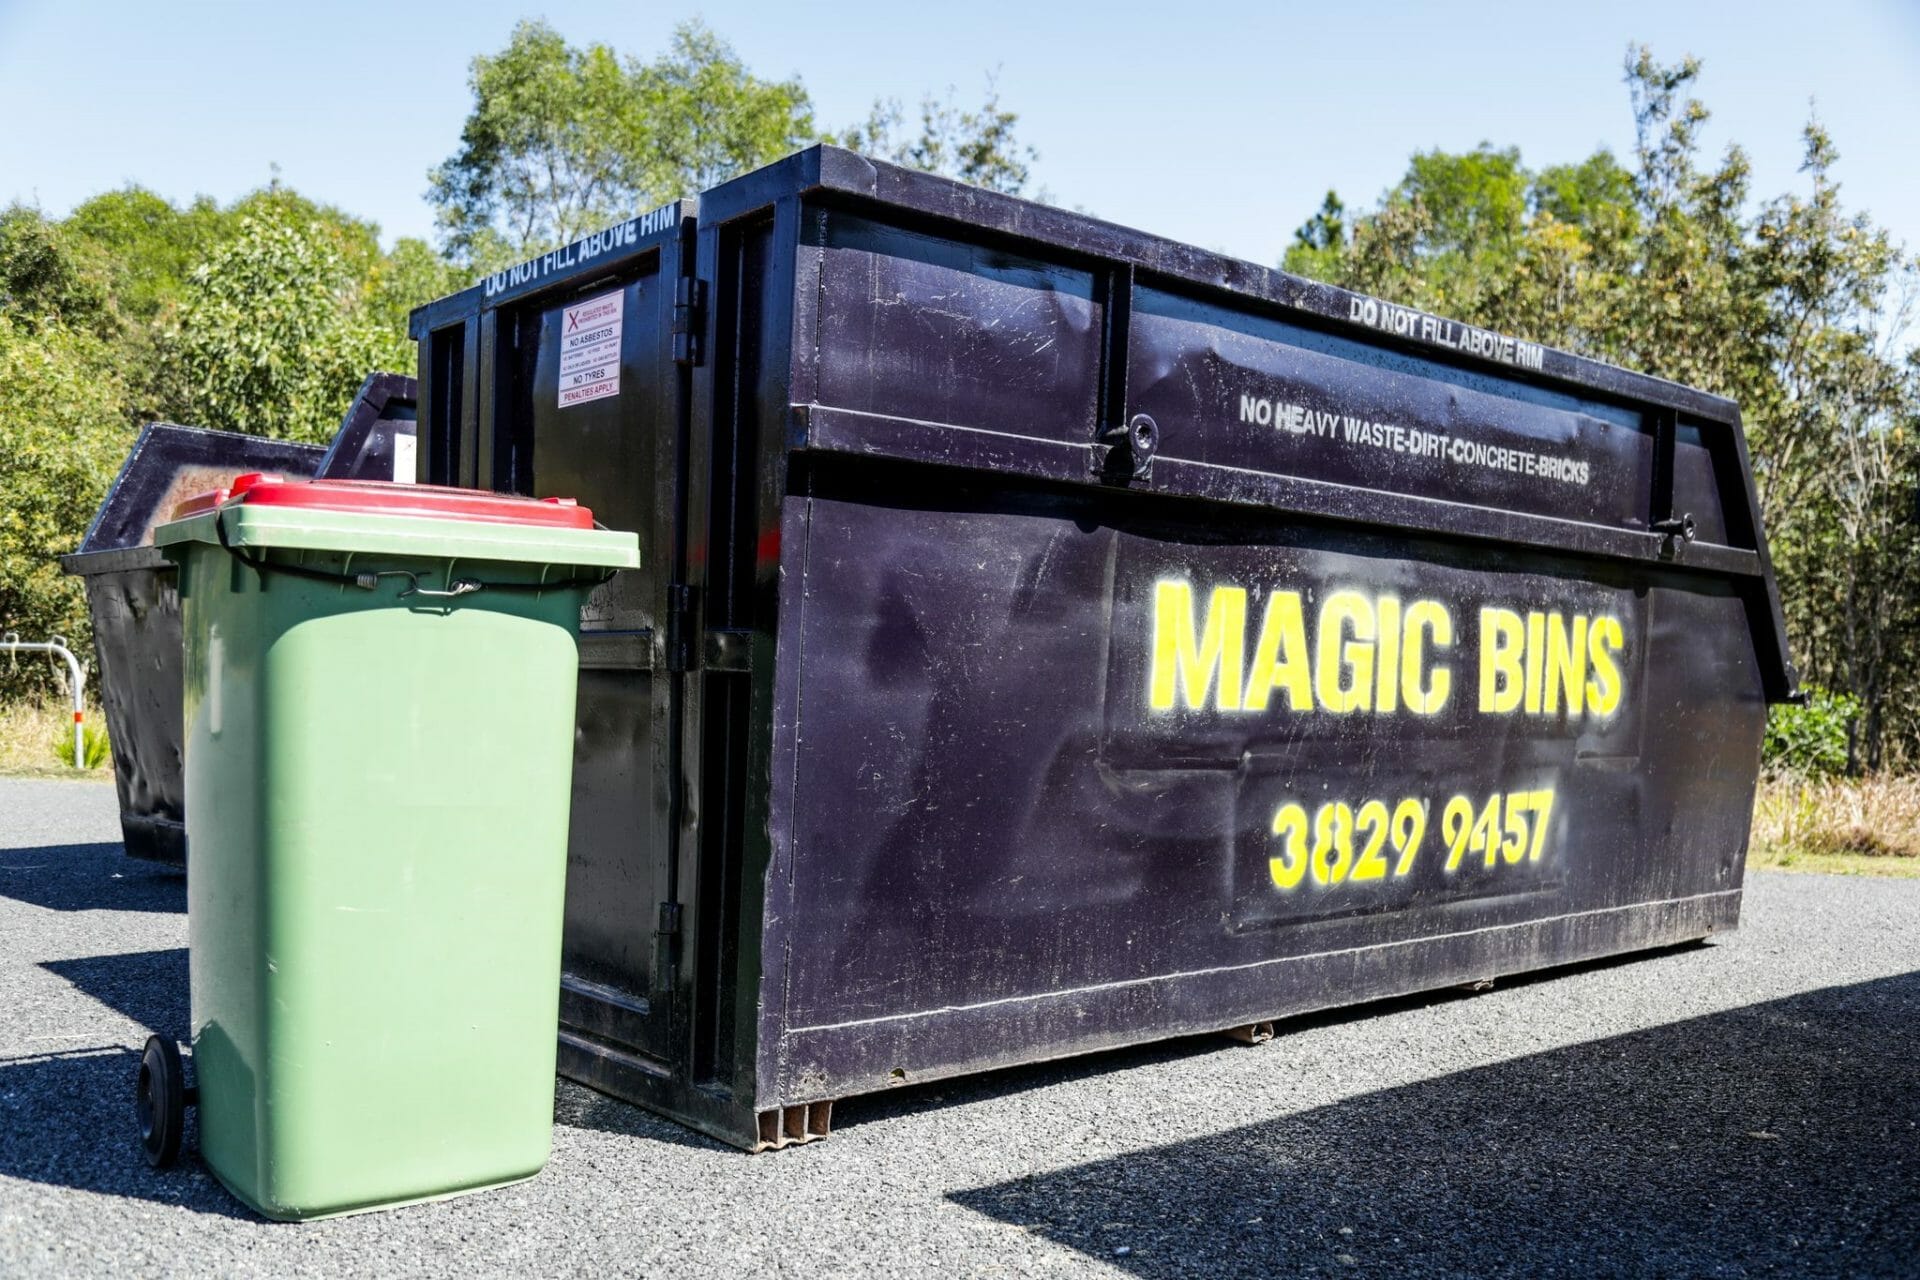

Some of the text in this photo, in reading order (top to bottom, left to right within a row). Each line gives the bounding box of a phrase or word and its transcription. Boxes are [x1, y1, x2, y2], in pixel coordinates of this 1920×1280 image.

[485, 273, 507, 297] DO
[509, 258, 538, 288] NOT
[543, 245, 575, 276] FILL
[578, 221, 637, 263] ABOVE
[569, 328, 613, 347] NO ASBESTOS
[1350, 297, 1543, 370] DO NOT FILL ABOVE RIM
[564, 382, 613, 401] PENALTIES APPLY
[573, 368, 605, 385] NO TYRES
[1240, 395, 1272, 425] NO
[1275, 402, 1340, 439] HEAVY
[1149, 580, 1624, 716] MAGIC BINS
[1269, 789, 1555, 889] 3829 9457
